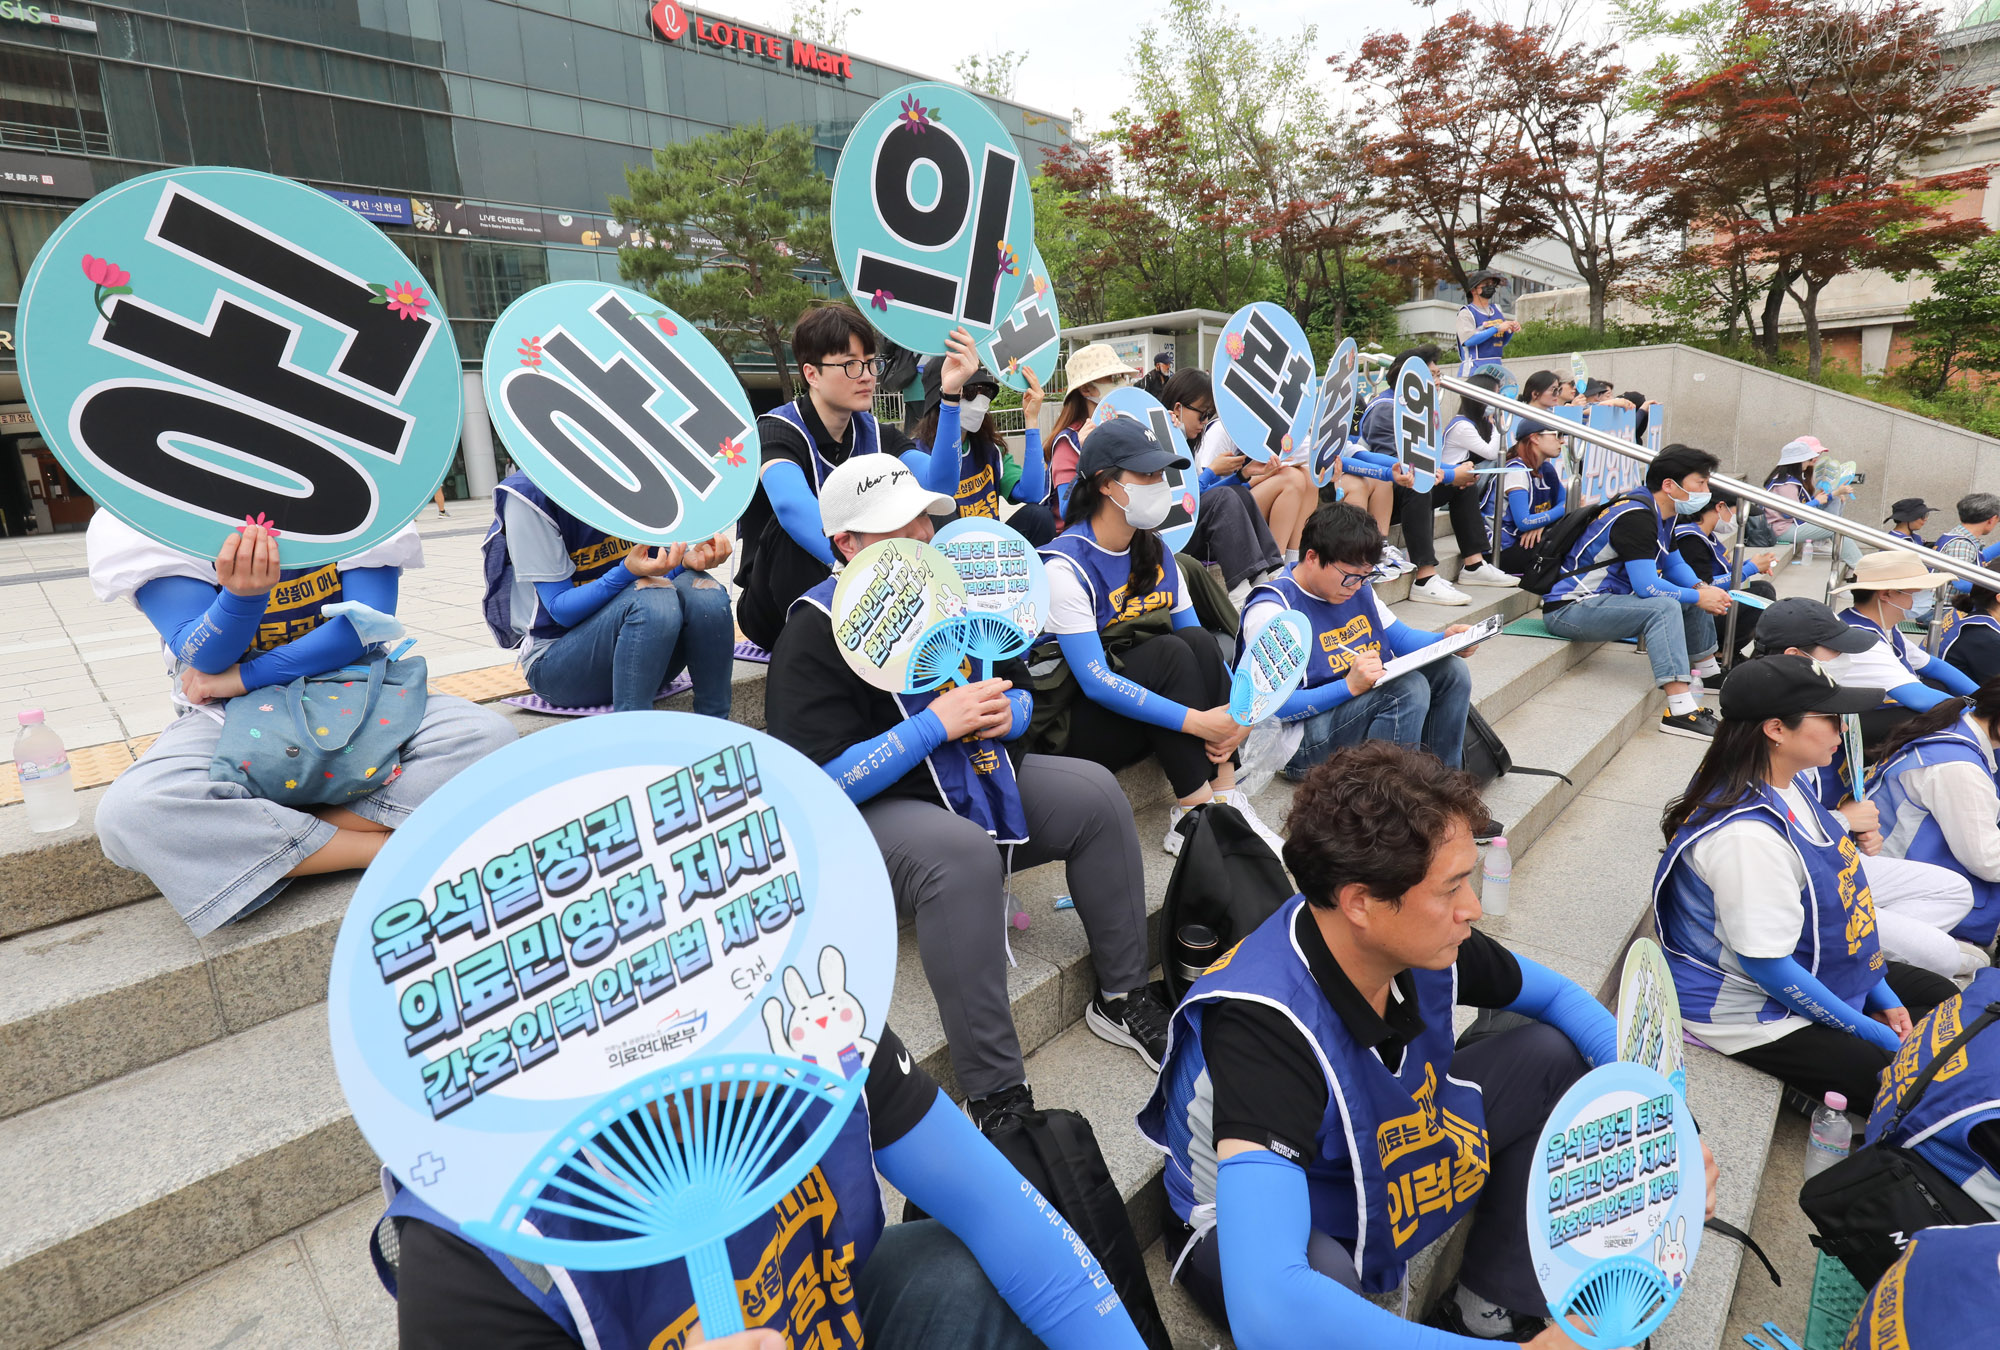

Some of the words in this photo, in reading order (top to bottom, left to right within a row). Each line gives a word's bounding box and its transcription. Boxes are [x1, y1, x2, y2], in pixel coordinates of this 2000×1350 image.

[696, 17, 784, 61] LOTTE
[793, 39, 853, 80] Mart
[479, 214, 496, 222] LIVE
[497, 216, 525, 226] CHEESE
[854, 119, 1018, 329] 의
[1222, 307, 1313, 456] 력
[1315, 346, 1357, 479] 충
[1401, 370, 1437, 478] 원
[856, 474, 887, 496] New
[998, 541, 1025, 558] 퇴진!
[1000, 560, 1028, 577] 저지!
[275, 581, 315, 606] 상품이
[372, 794, 644, 984] 윤석열정권
[646, 741, 764, 845] 퇴진!
[399, 863, 667, 1056] 의료민영화
[671, 806, 787, 912] 저지!
[421, 917, 714, 1121] 간호인력인권법
[715, 870, 806, 955] 제정!
[608, 1026, 698, 1069] 의료연대본부
[1378, 1123, 1422, 1159] 의료는
[1547, 1107, 1633, 1174] 윤석열정권
[1637, 1094, 1674, 1138] 퇴진!
[1548, 1146, 1637, 1213] 의료민영화
[1639, 1132, 1677, 1177] 저지!
[1550, 1182, 1646, 1250] 간호인력인권법
[1648, 1170, 1679, 1206] 제정!
